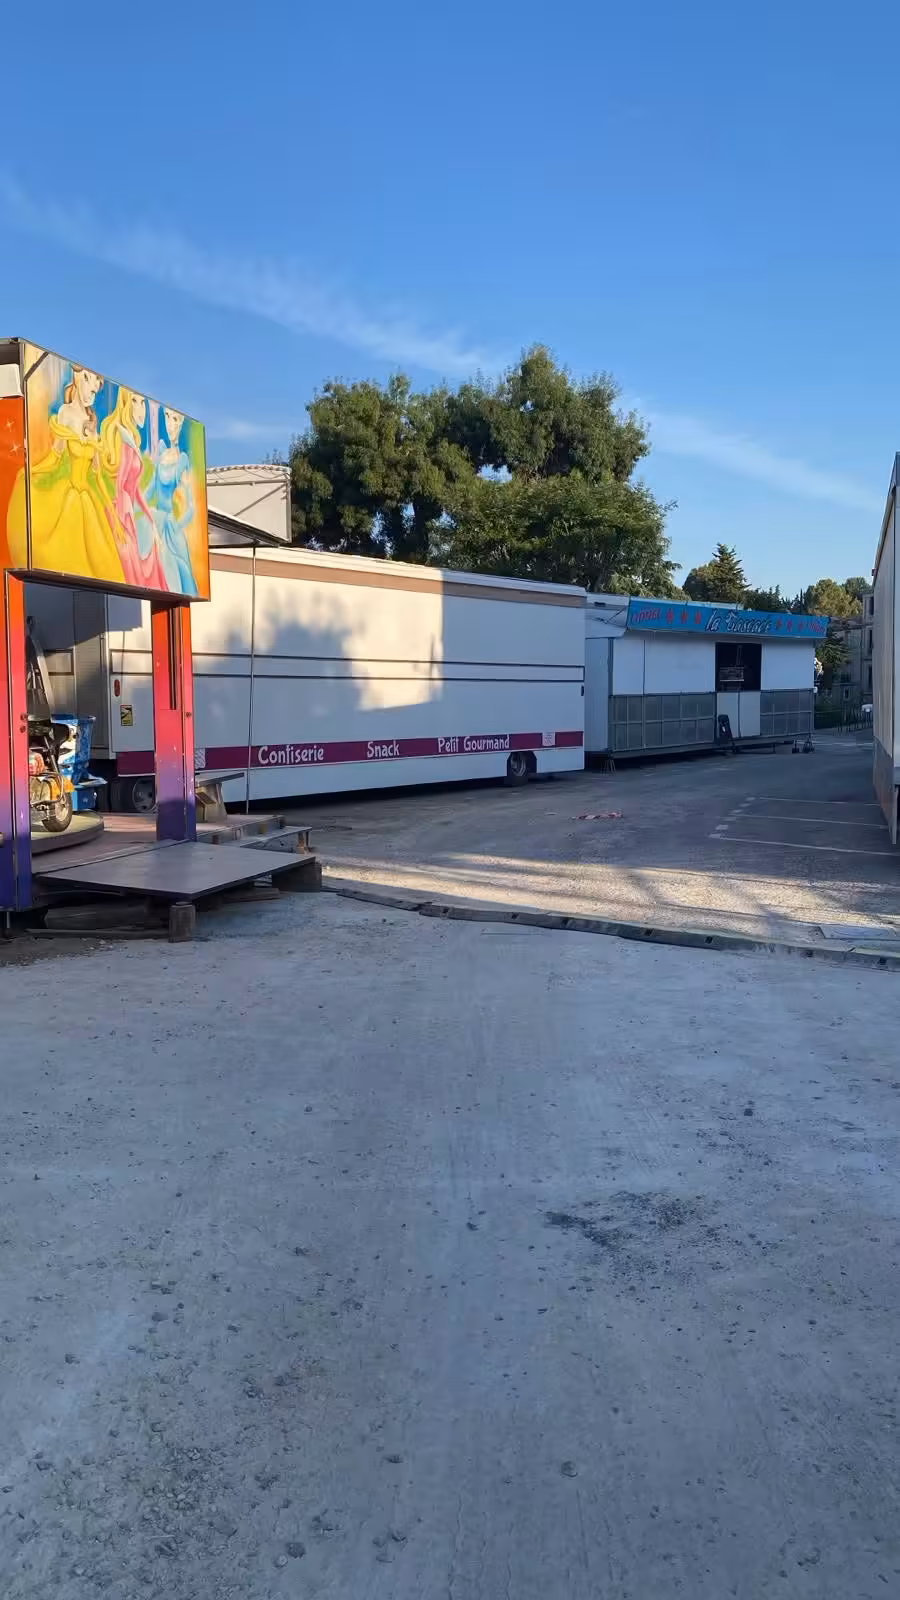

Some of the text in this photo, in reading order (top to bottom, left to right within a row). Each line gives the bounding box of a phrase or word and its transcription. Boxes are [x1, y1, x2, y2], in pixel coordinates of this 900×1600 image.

[258, 734, 510, 764] Confiserie Snack Petit Gourmand
